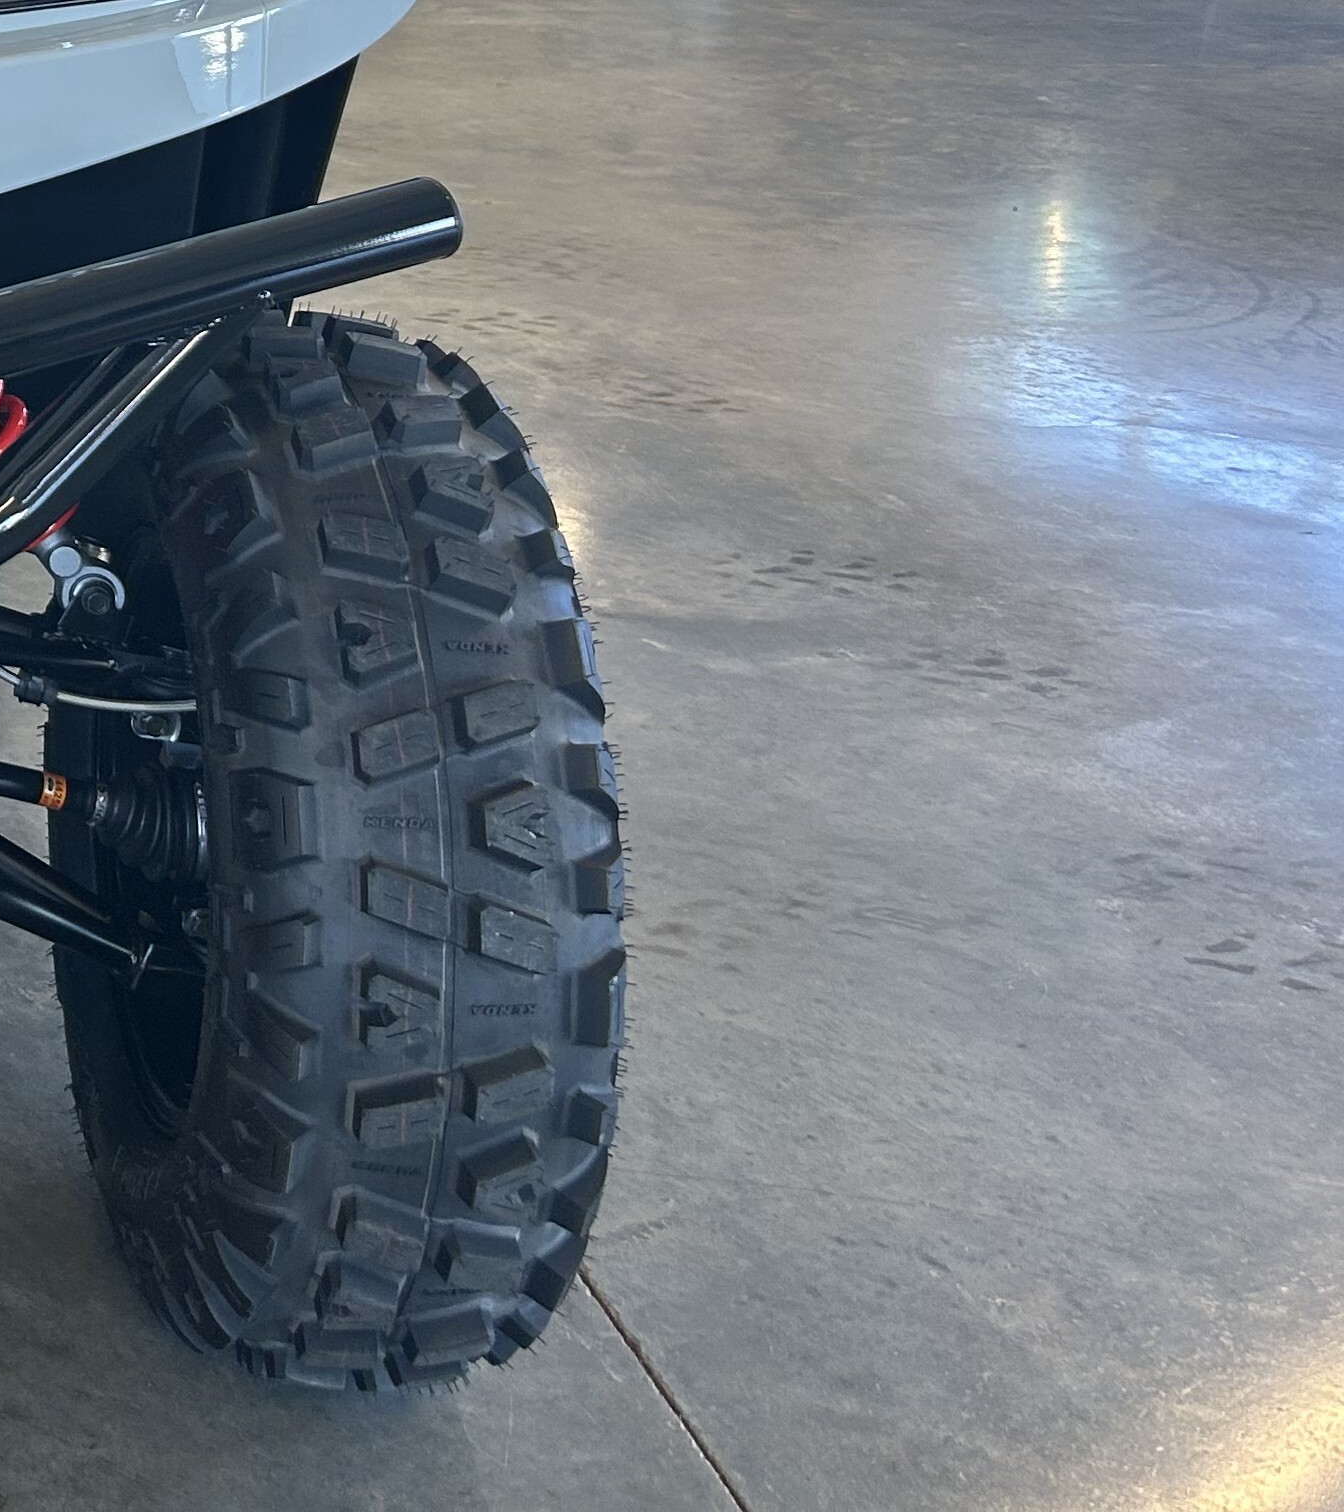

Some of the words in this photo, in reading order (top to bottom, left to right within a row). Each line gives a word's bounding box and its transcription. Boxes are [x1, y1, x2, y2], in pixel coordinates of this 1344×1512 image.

[444, 639, 511, 655] KENDA
[362, 815, 433, 829] KENDA
[470, 1003, 538, 1016] KENDA
